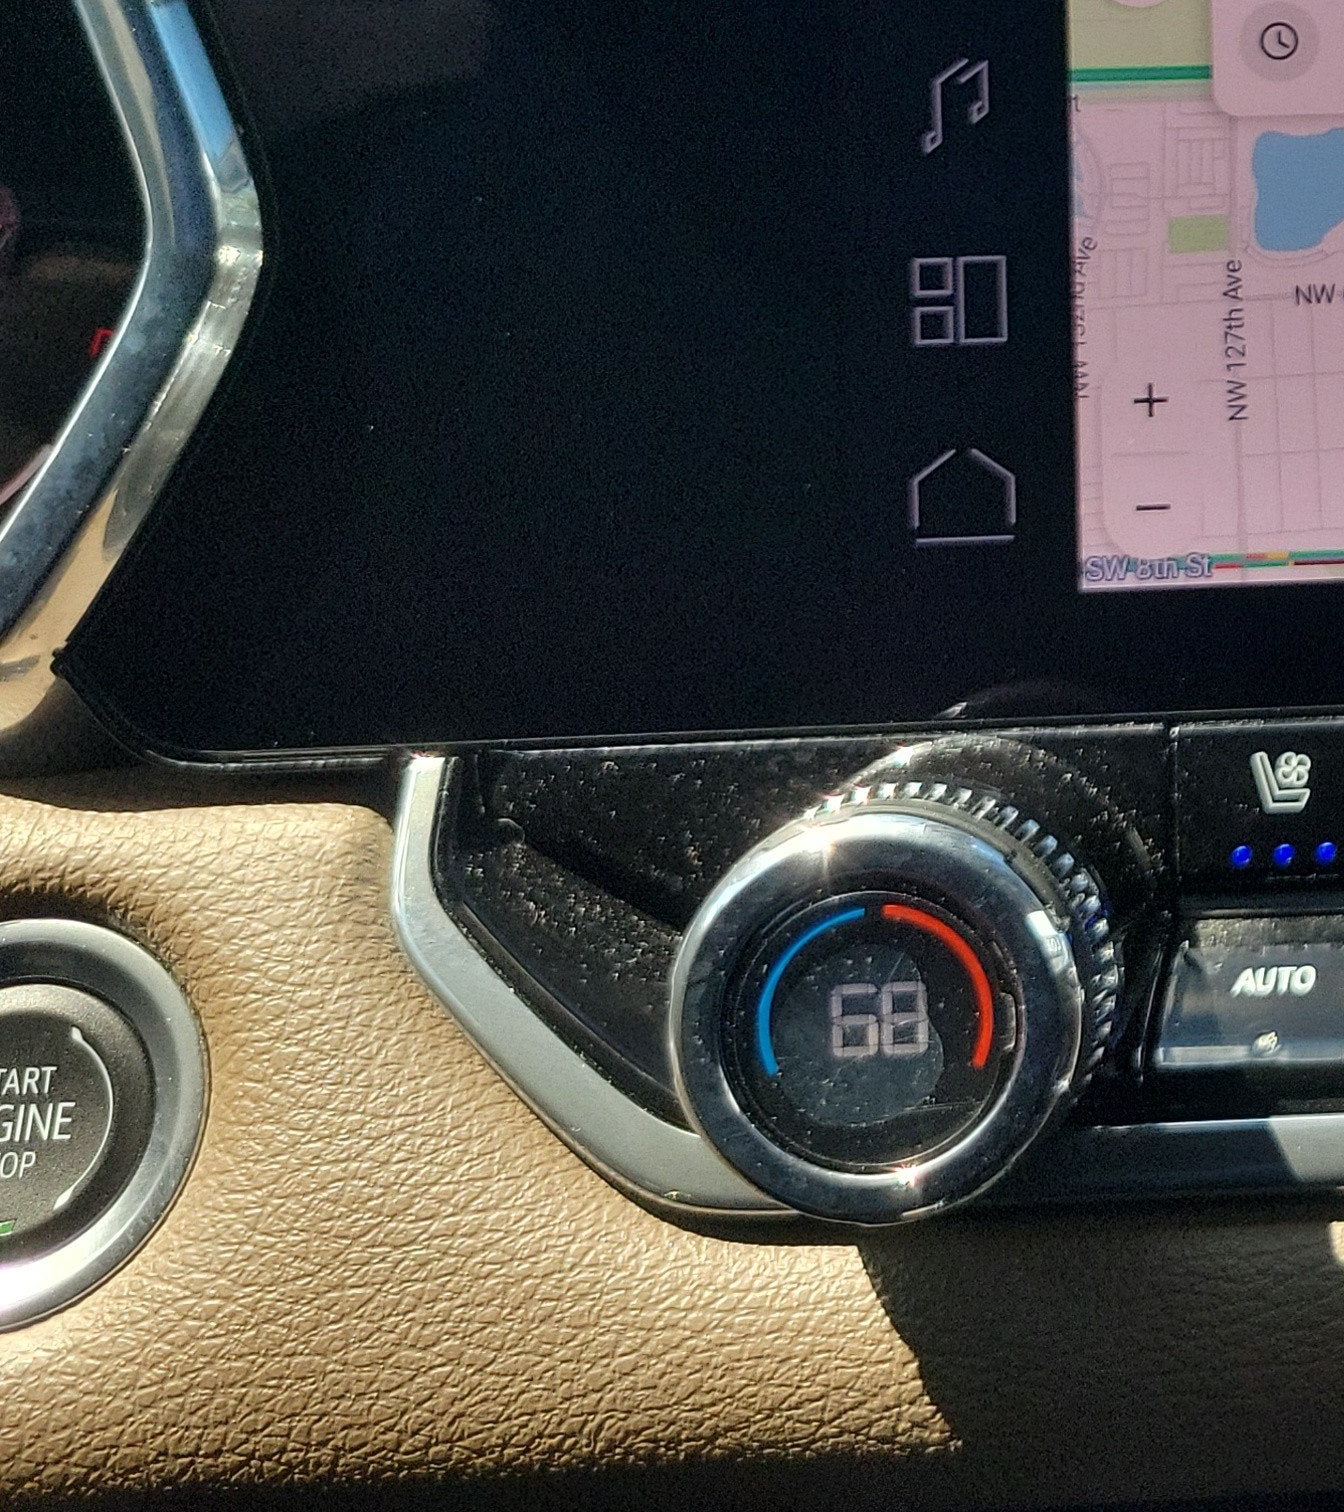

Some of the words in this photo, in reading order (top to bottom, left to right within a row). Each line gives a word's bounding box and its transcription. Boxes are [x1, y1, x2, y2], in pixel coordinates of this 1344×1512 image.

[1223, 259, 1243, 301] Ave
[1296, 284, 1335, 304] NW
[1223, 308, 1247, 372] 127th
[1226, 380, 1248, 421] NW
[1085, 554, 1129, 581] SW
[1135, 556, 1179, 580] 8th
[1185, 551, 1212, 578] St
[1231, 962, 1317, 999] AUTO
[831, 981, 928, 1058] 68
